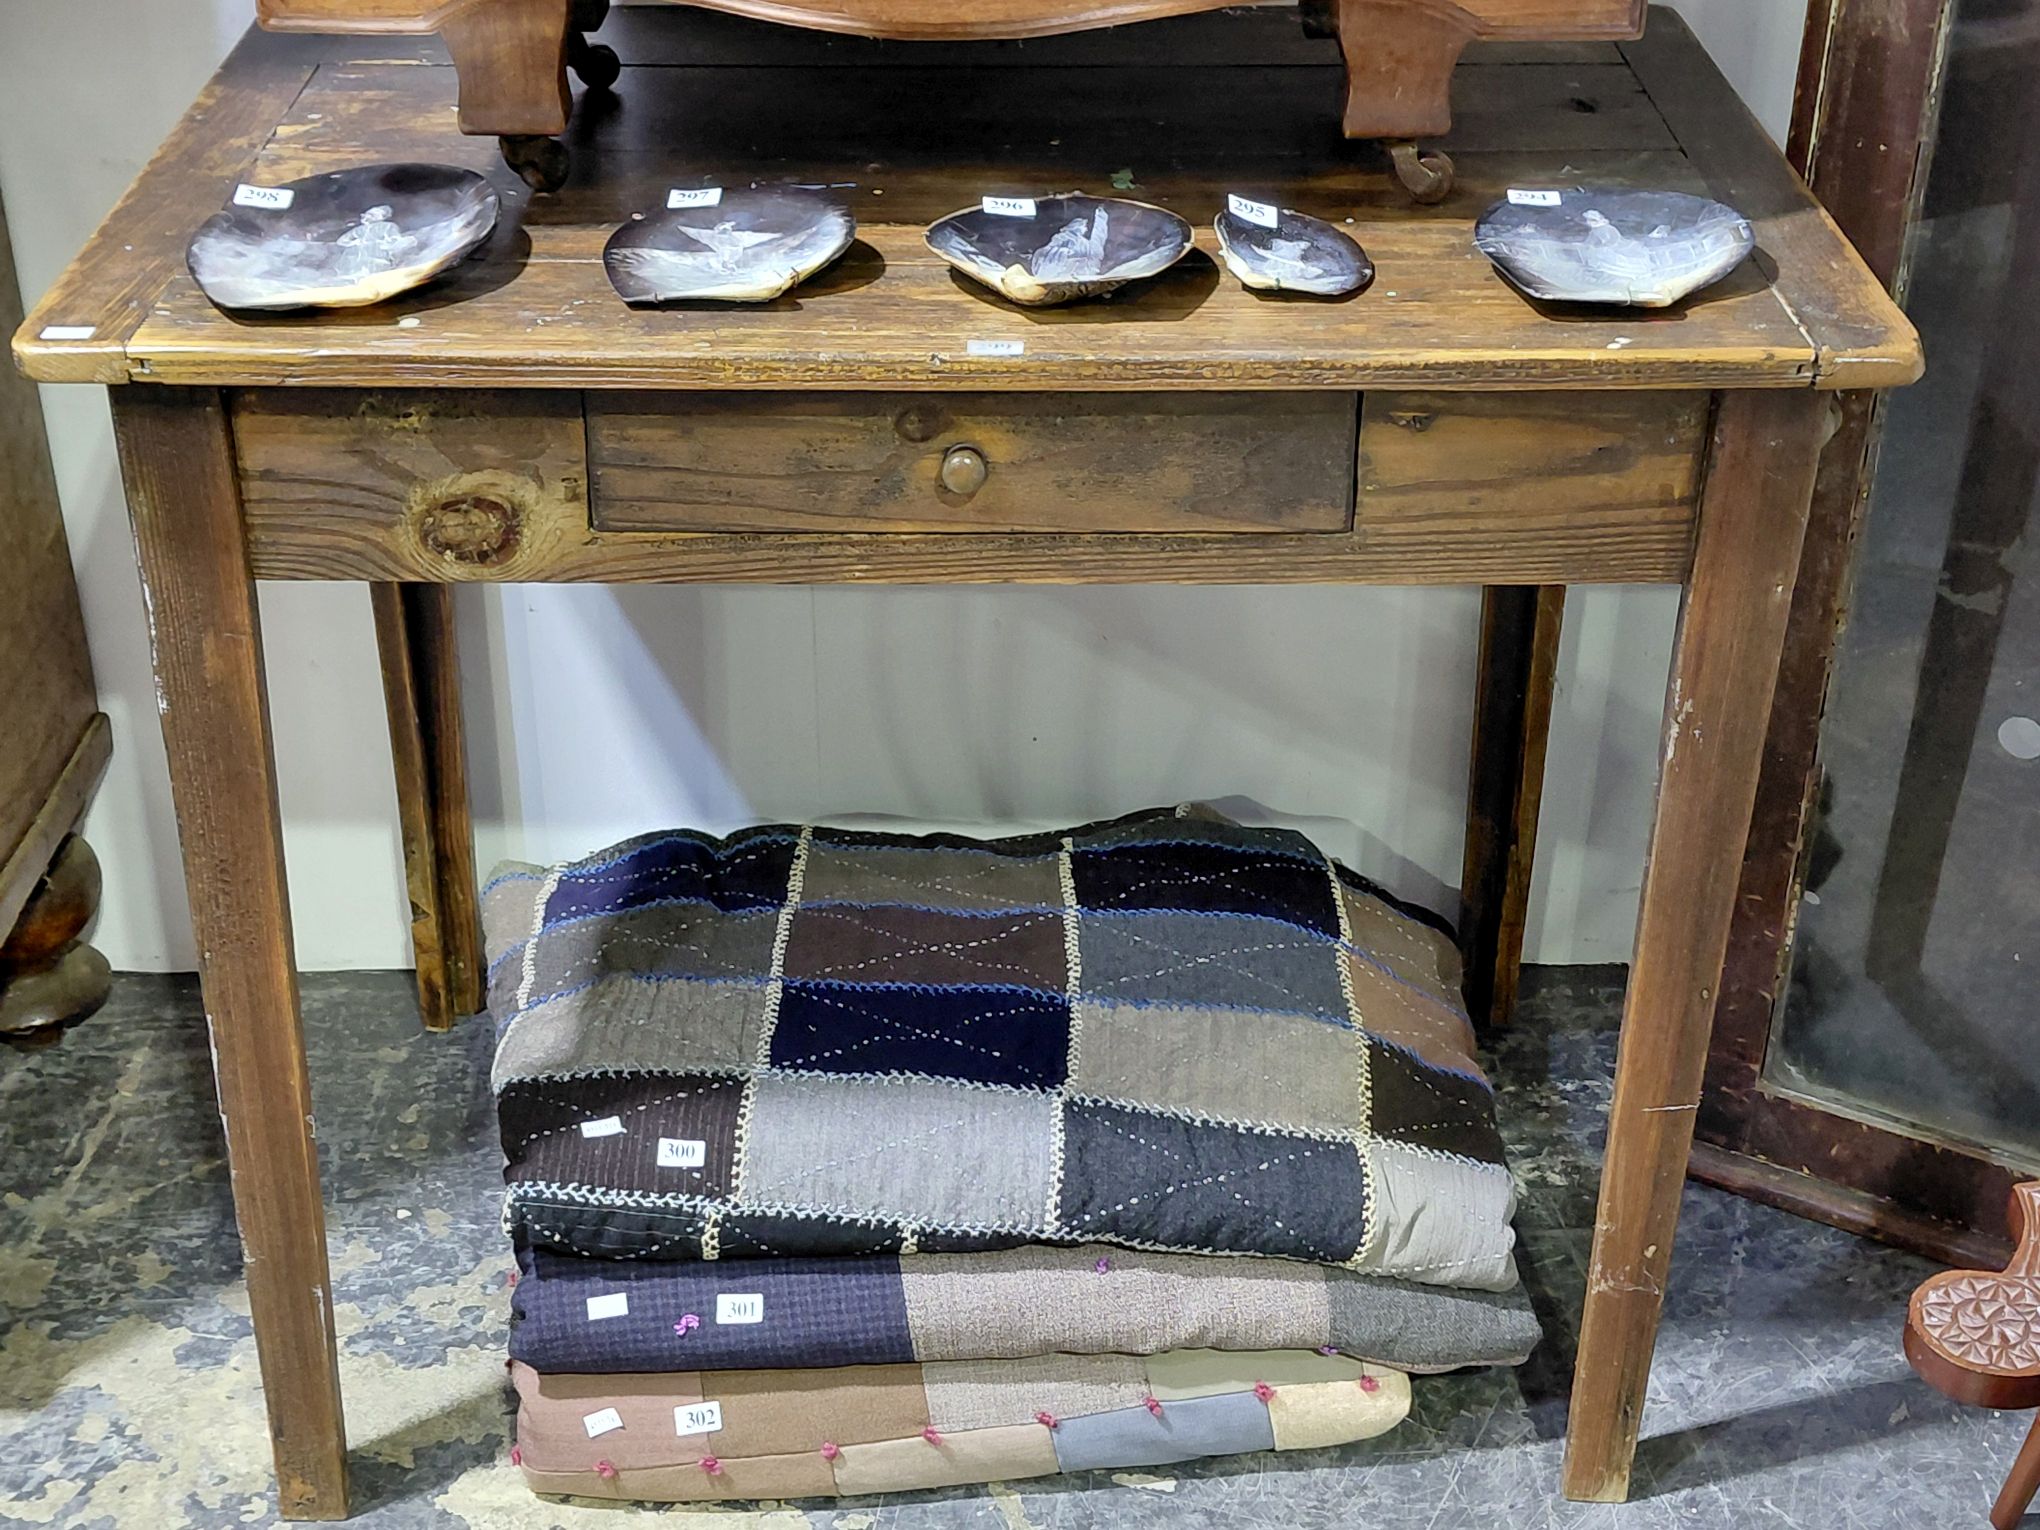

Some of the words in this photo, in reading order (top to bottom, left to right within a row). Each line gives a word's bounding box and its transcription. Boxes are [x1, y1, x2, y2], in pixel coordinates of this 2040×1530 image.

[244, 190, 279, 202] 298
[677, 191, 709, 203] 297
[990, 200, 1023, 210] 296
[1234, 199, 1265, 218] 295
[664, 1143, 696, 1159] 300
[728, 1301, 756, 1318] 301
[686, 1409, 716, 1428] 302
